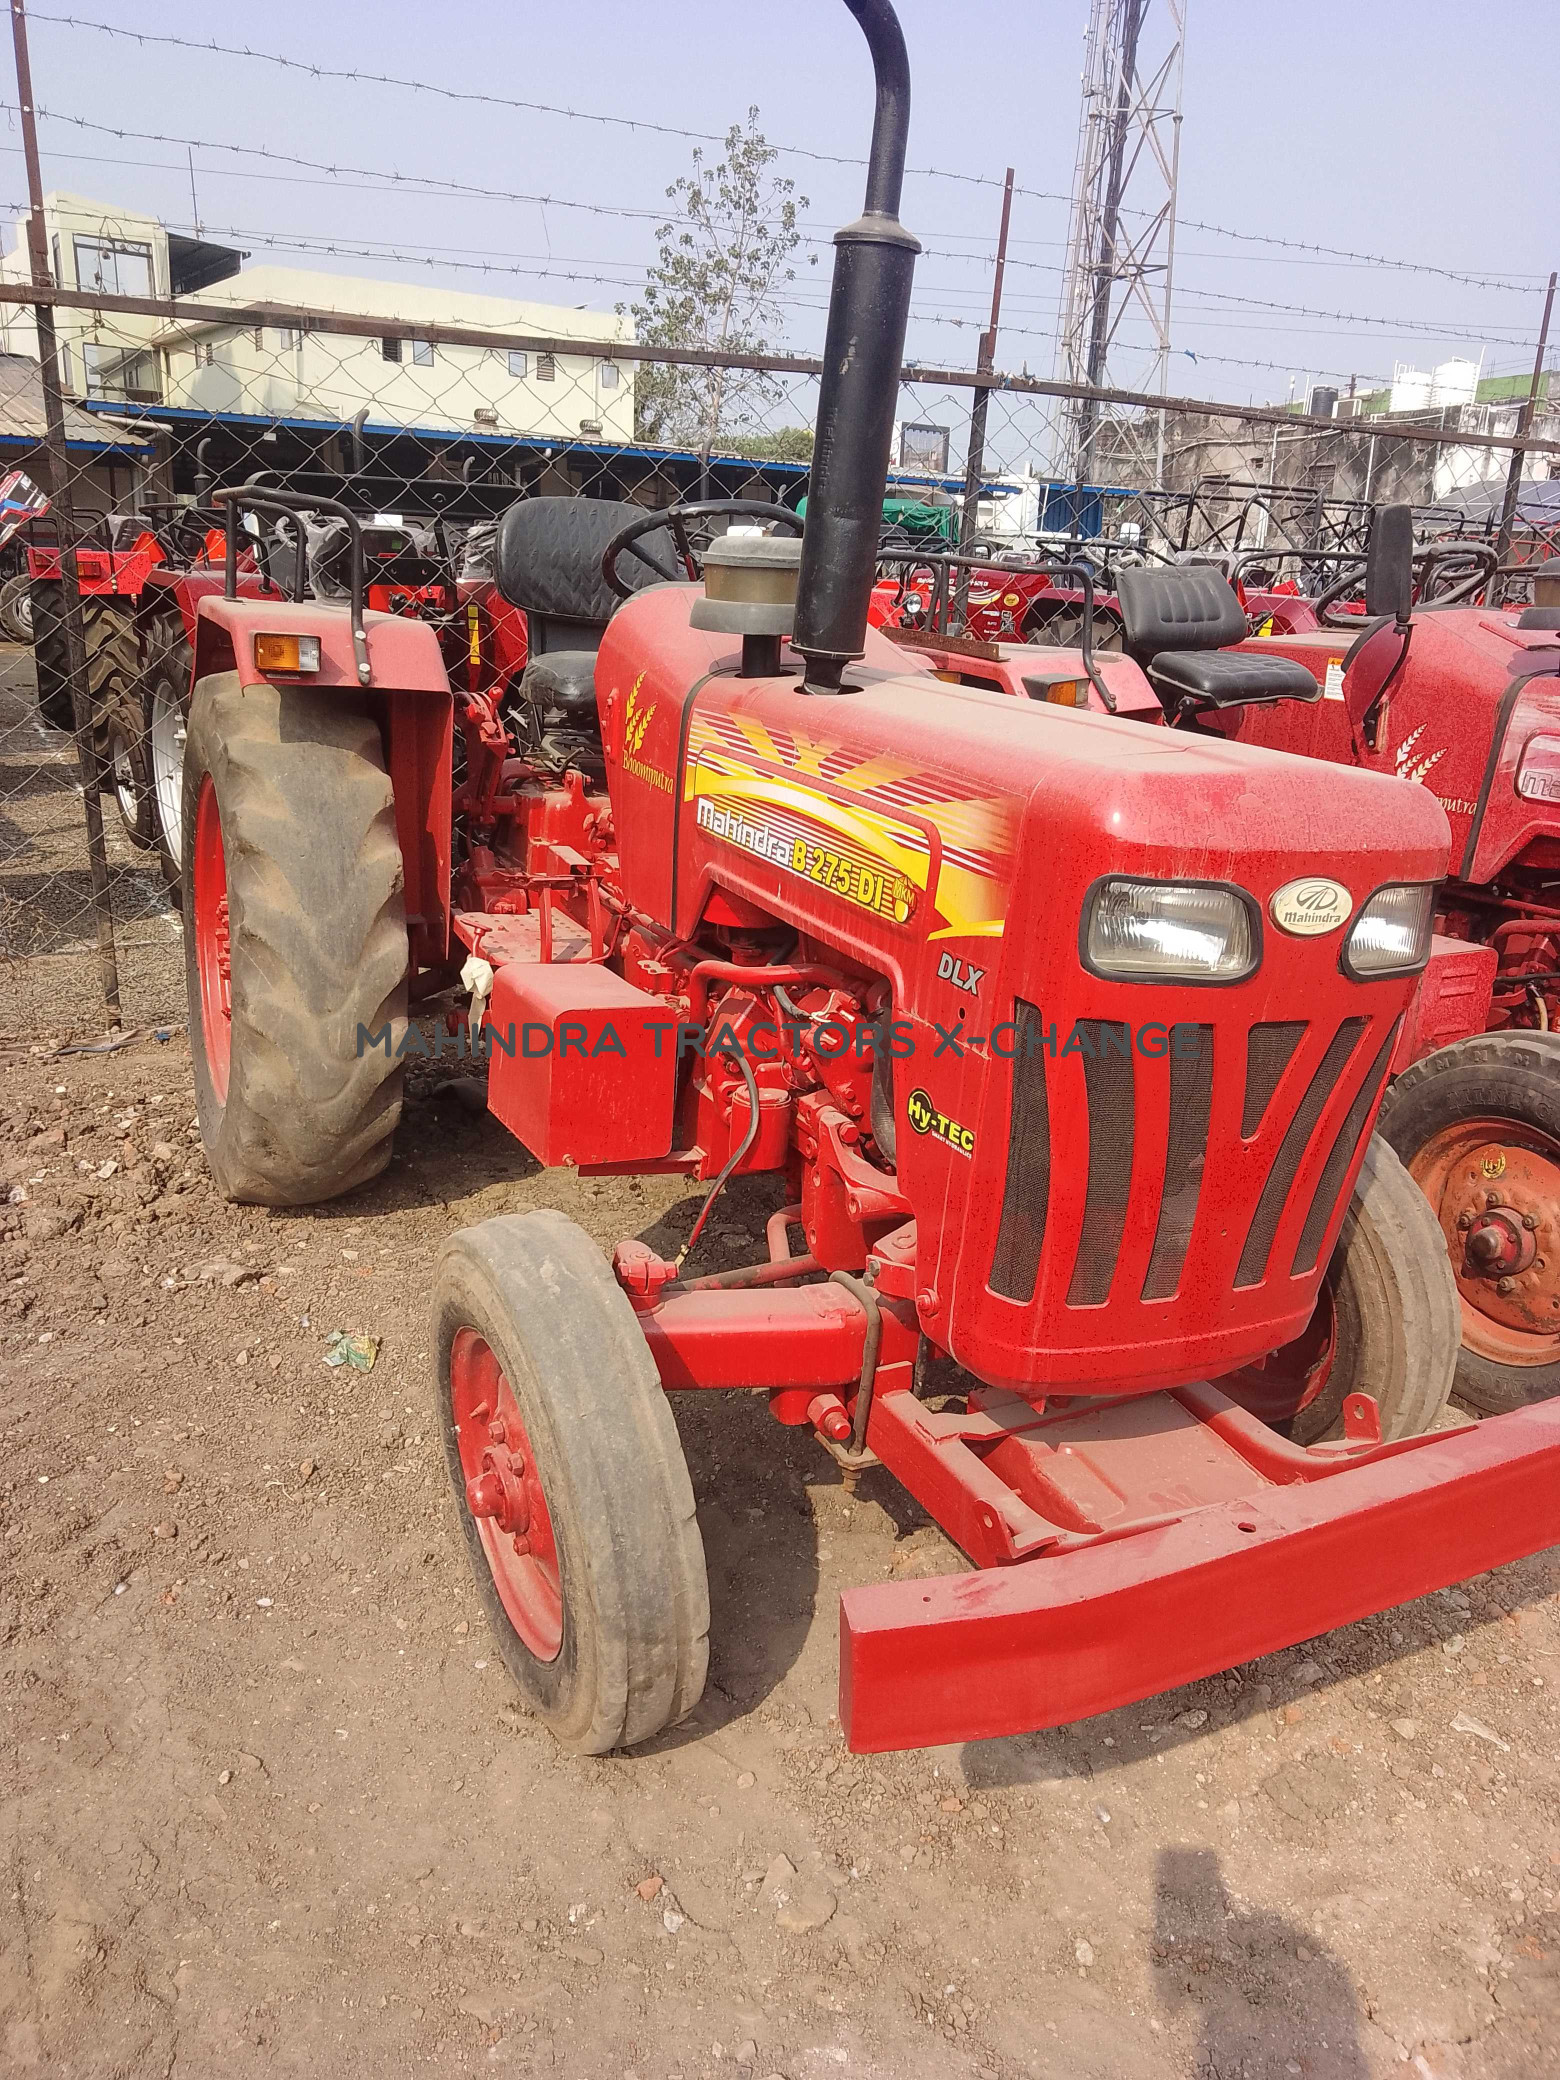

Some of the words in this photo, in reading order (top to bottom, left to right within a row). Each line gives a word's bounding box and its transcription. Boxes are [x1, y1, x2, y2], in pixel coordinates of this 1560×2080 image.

[696, 797, 790, 866] Mahindra
[809, 847, 853, 894] 275
[857, 867, 885, 911] DI
[1283, 912, 1341, 923] Mahindra
[937, 952, 984, 996] DLX
[908, 1097, 973, 1152] Hy-TEC
